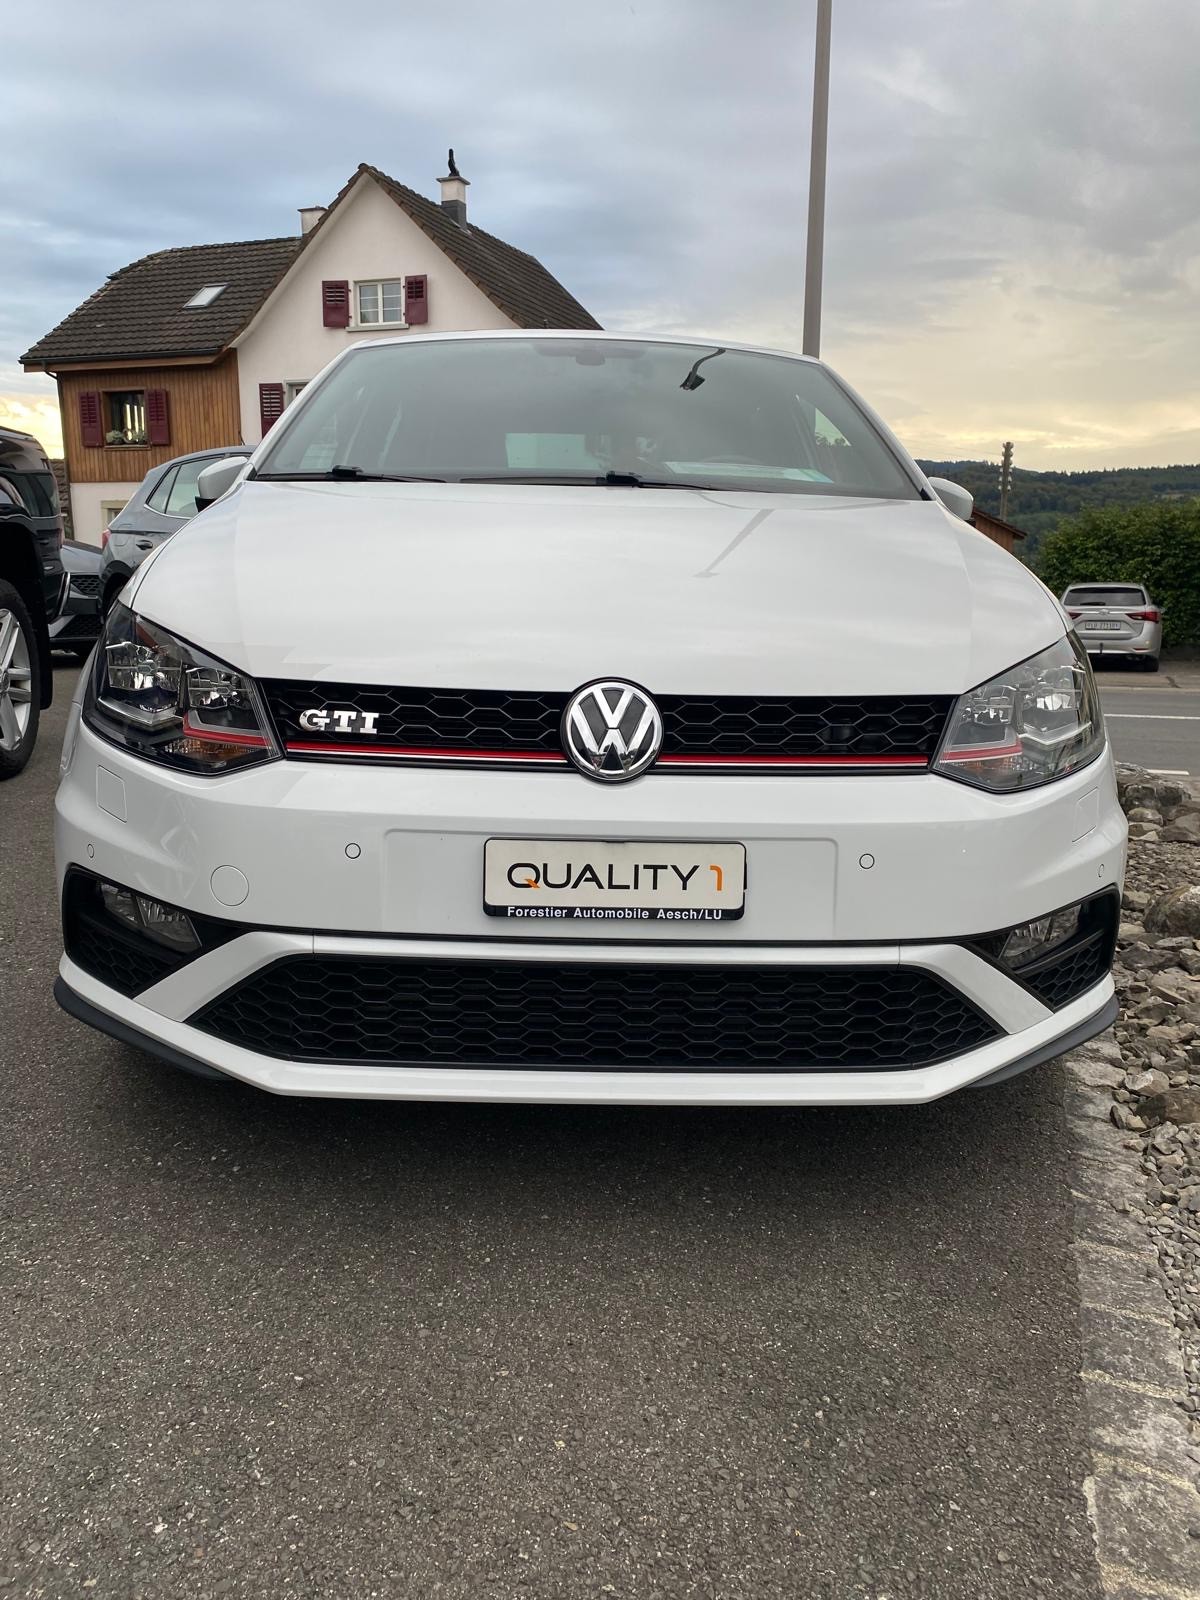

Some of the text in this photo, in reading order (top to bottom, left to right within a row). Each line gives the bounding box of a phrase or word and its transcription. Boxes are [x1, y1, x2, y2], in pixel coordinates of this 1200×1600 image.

[299, 708, 380, 735] GTI
[567, 683, 660, 776] VW
[506, 862, 723, 892] QUALITY 1
[507, 906, 722, 920] Forestier Automobile Aesch/LU
